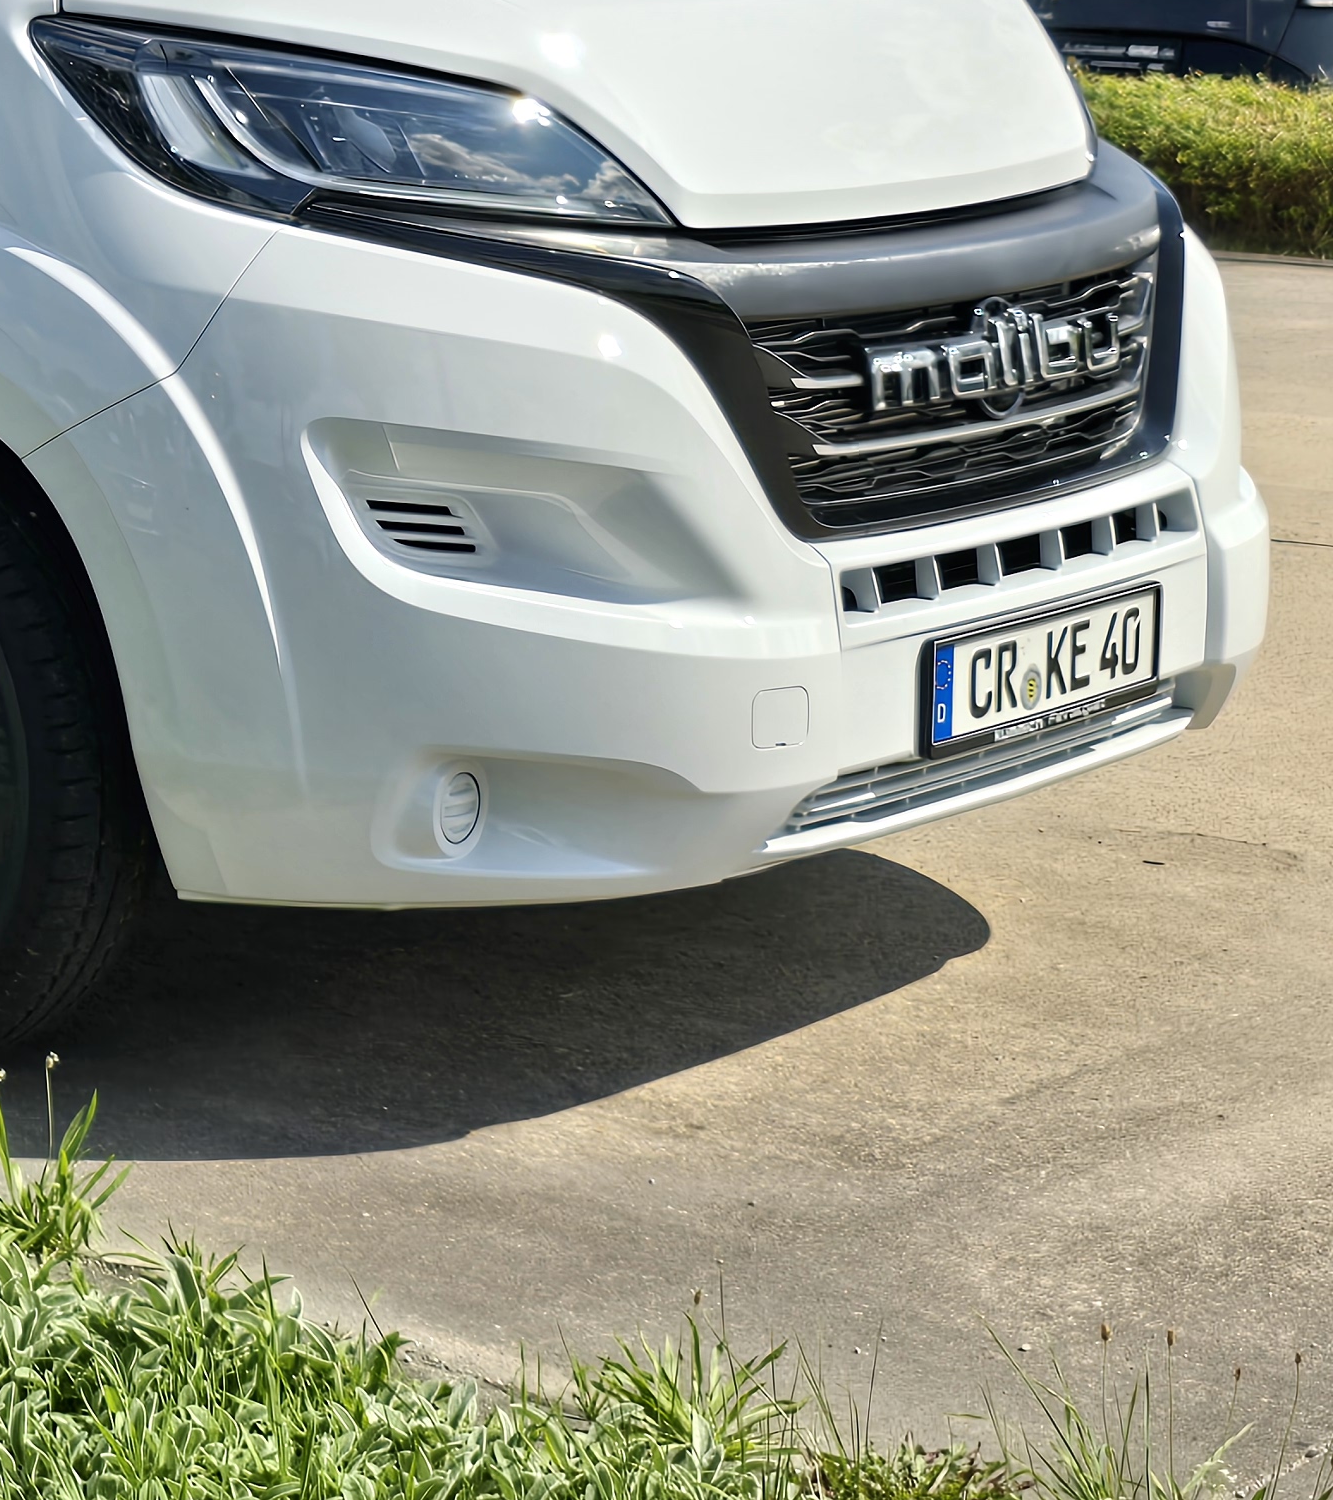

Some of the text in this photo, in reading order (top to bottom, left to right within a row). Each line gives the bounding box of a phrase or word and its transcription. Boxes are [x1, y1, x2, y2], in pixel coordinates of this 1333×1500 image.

[869, 307, 1123, 412] malibu
[937, 703, 947, 724] D
[968, 639, 1018, 720] CR
[1045, 618, 1091, 700] KE
[1099, 606, 1142, 680] 40
